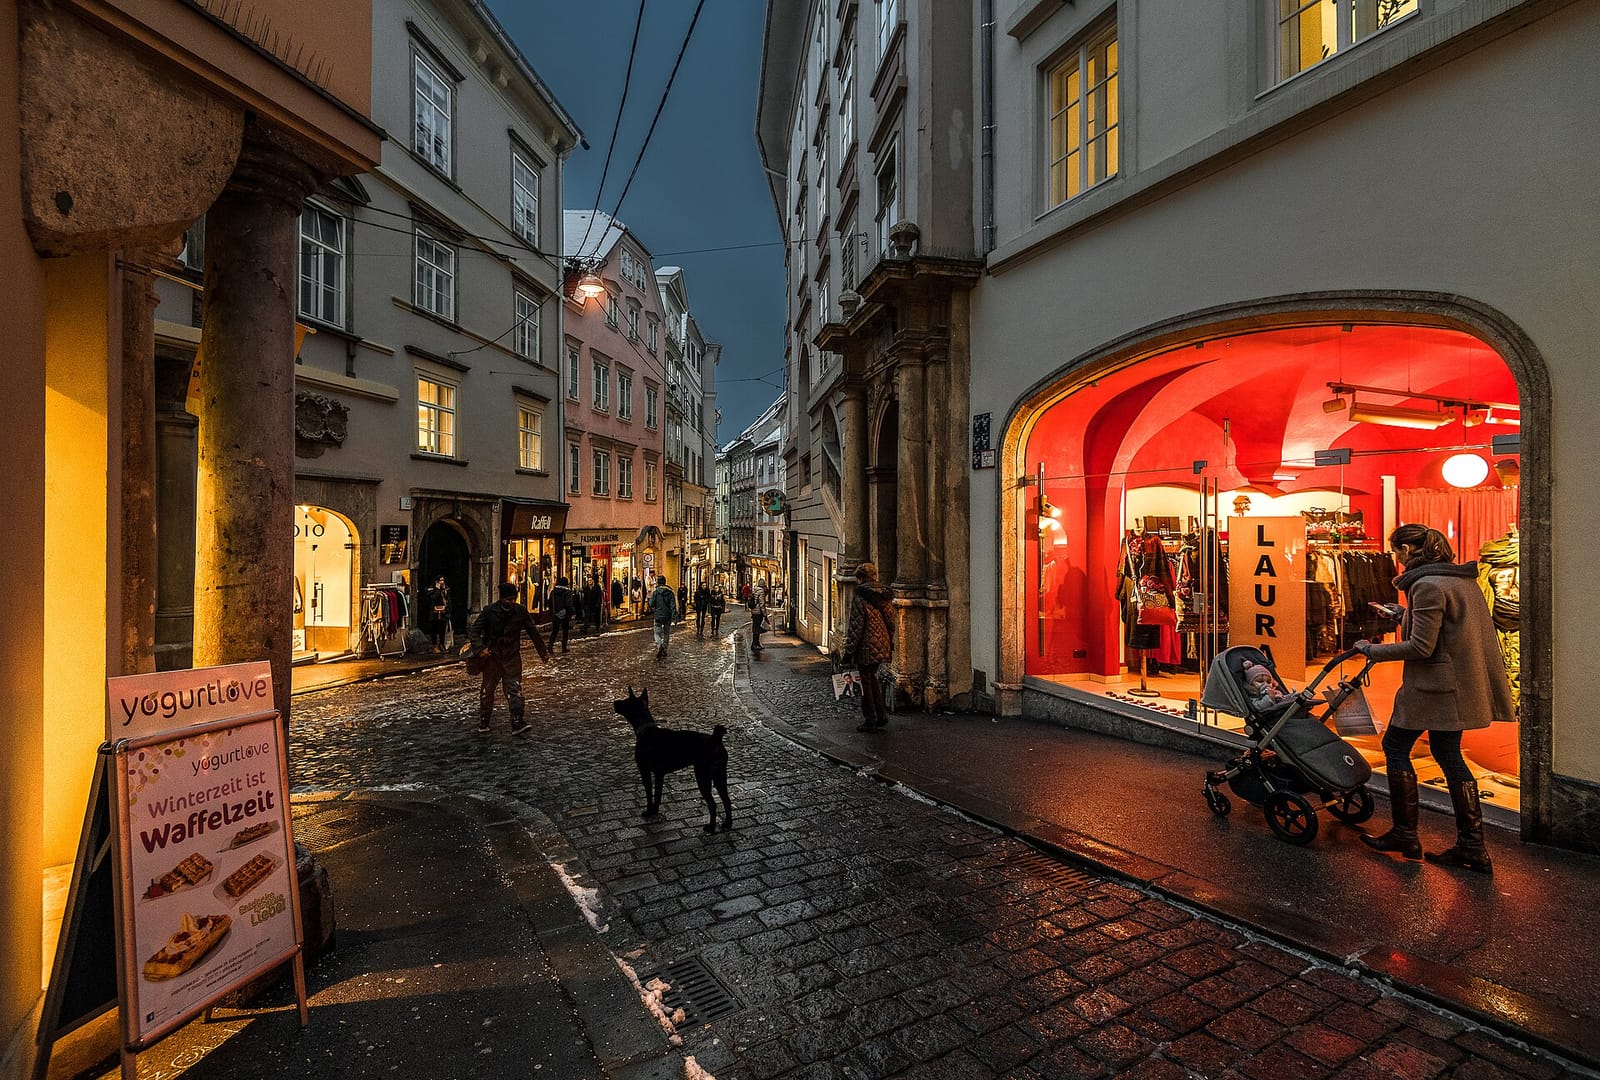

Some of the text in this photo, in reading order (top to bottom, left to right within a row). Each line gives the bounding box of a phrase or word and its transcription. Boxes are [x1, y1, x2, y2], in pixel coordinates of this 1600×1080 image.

[601, 533, 619, 542] GALERIE
[1254, 524, 1277, 669] LAURA
[120, 679, 267, 727] yogurtlove
[191, 742, 270, 777] yogurtlove
[147, 770, 266, 819] Winterzeit ist
[140, 790, 275, 854] Waffelzeit
